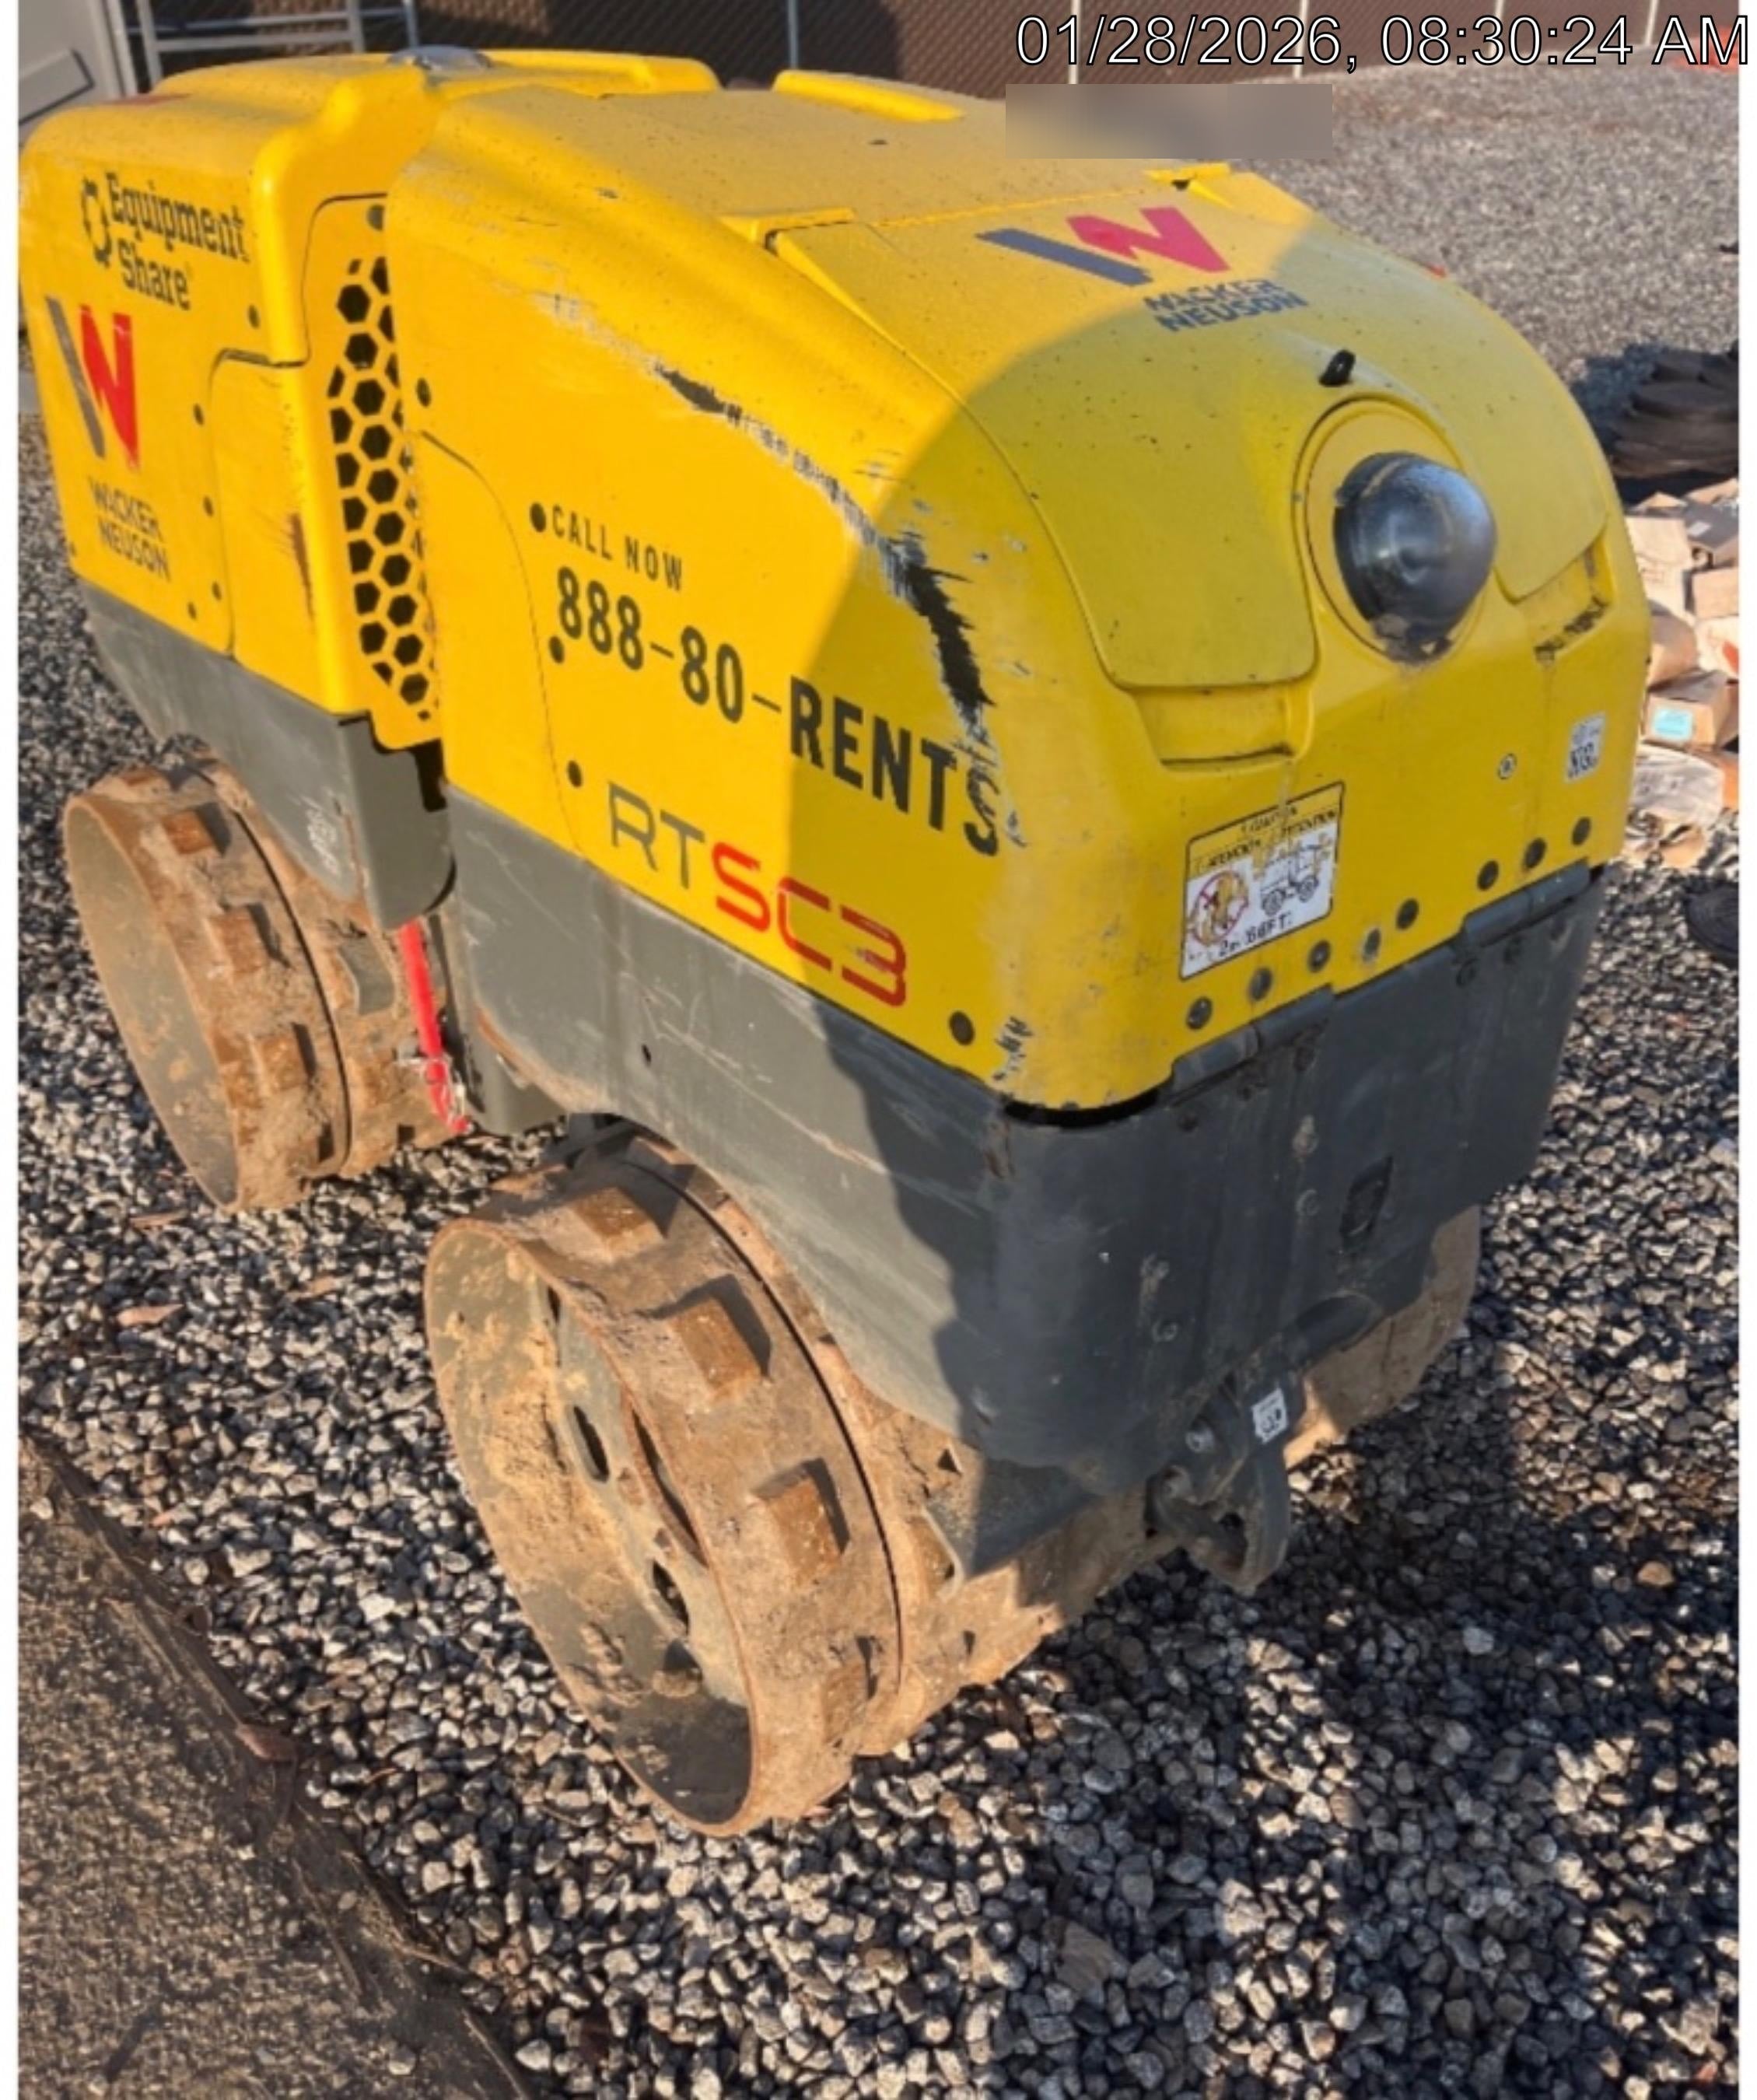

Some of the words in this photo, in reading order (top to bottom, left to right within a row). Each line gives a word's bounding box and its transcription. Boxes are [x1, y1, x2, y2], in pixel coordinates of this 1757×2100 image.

[106, 171, 247, 262] Equipment
[117, 237, 191, 312] Share
[1143, 278, 1285, 313] WACKER
[1154, 291, 1310, 333] NEUSON
[86, 475, 166, 544] WACKER
[97, 514, 173, 584] NEUSON
[551, 503, 613, 562] CALL
[625, 534, 683, 593] NOW
[557, 565, 1000, 858] 888-80-RENTS
